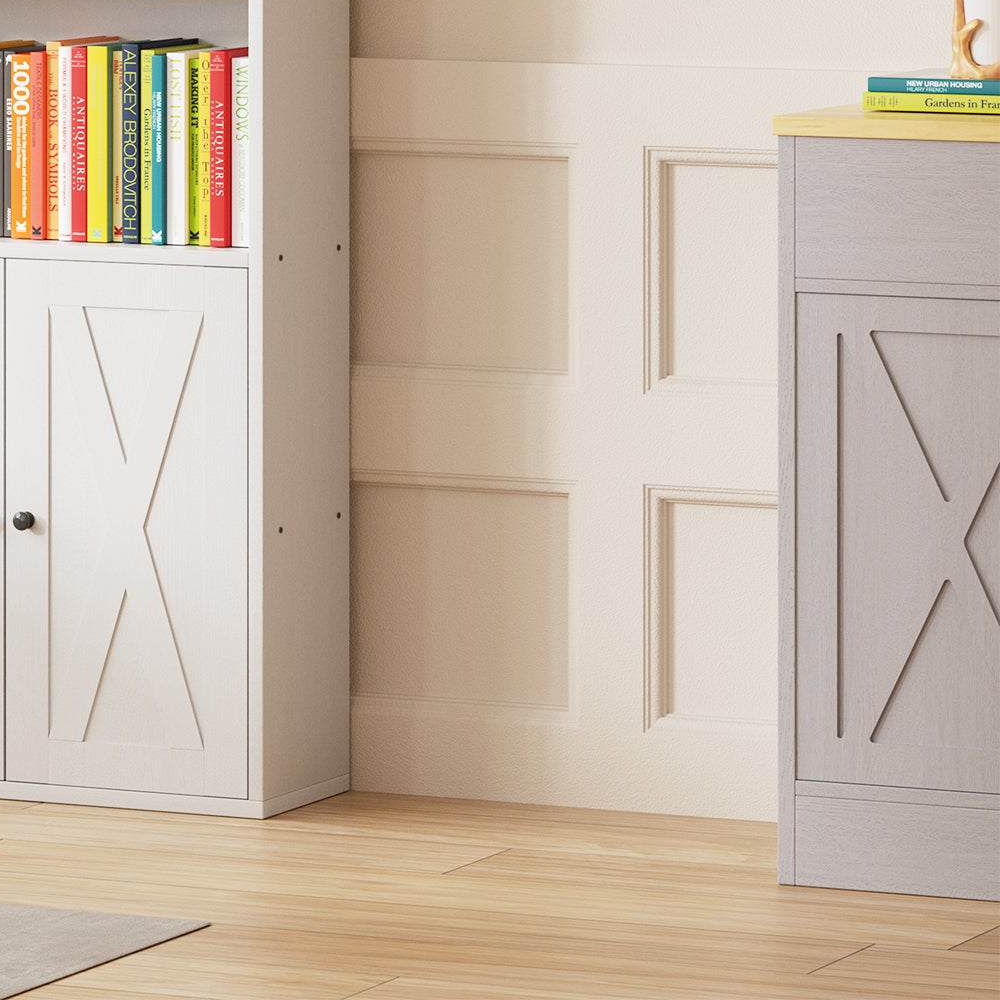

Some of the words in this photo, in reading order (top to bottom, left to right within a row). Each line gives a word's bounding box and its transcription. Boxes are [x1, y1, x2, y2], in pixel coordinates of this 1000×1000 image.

[13, 61, 30, 115] 1000
[48, 89, 58, 128] BOOK
[124, 49, 136, 115] ALEXEY
[236, 65, 248, 141] WINDOWS
[925, 98, 966, 108] Gardens
[968, 99, 978, 108] in
[950, 81, 983, 89] HOUSING
[76, 96, 85, 191] ANTIQUAIRES
[144, 108, 152, 146] Gardens
[191, 117, 198, 128] IT
[215, 100, 224, 197] ANTIQUAIRES
[48, 143, 58, 212] SYMBOLS
[124, 120, 136, 230] BRODOVITCH
[144, 148, 151, 157] in
